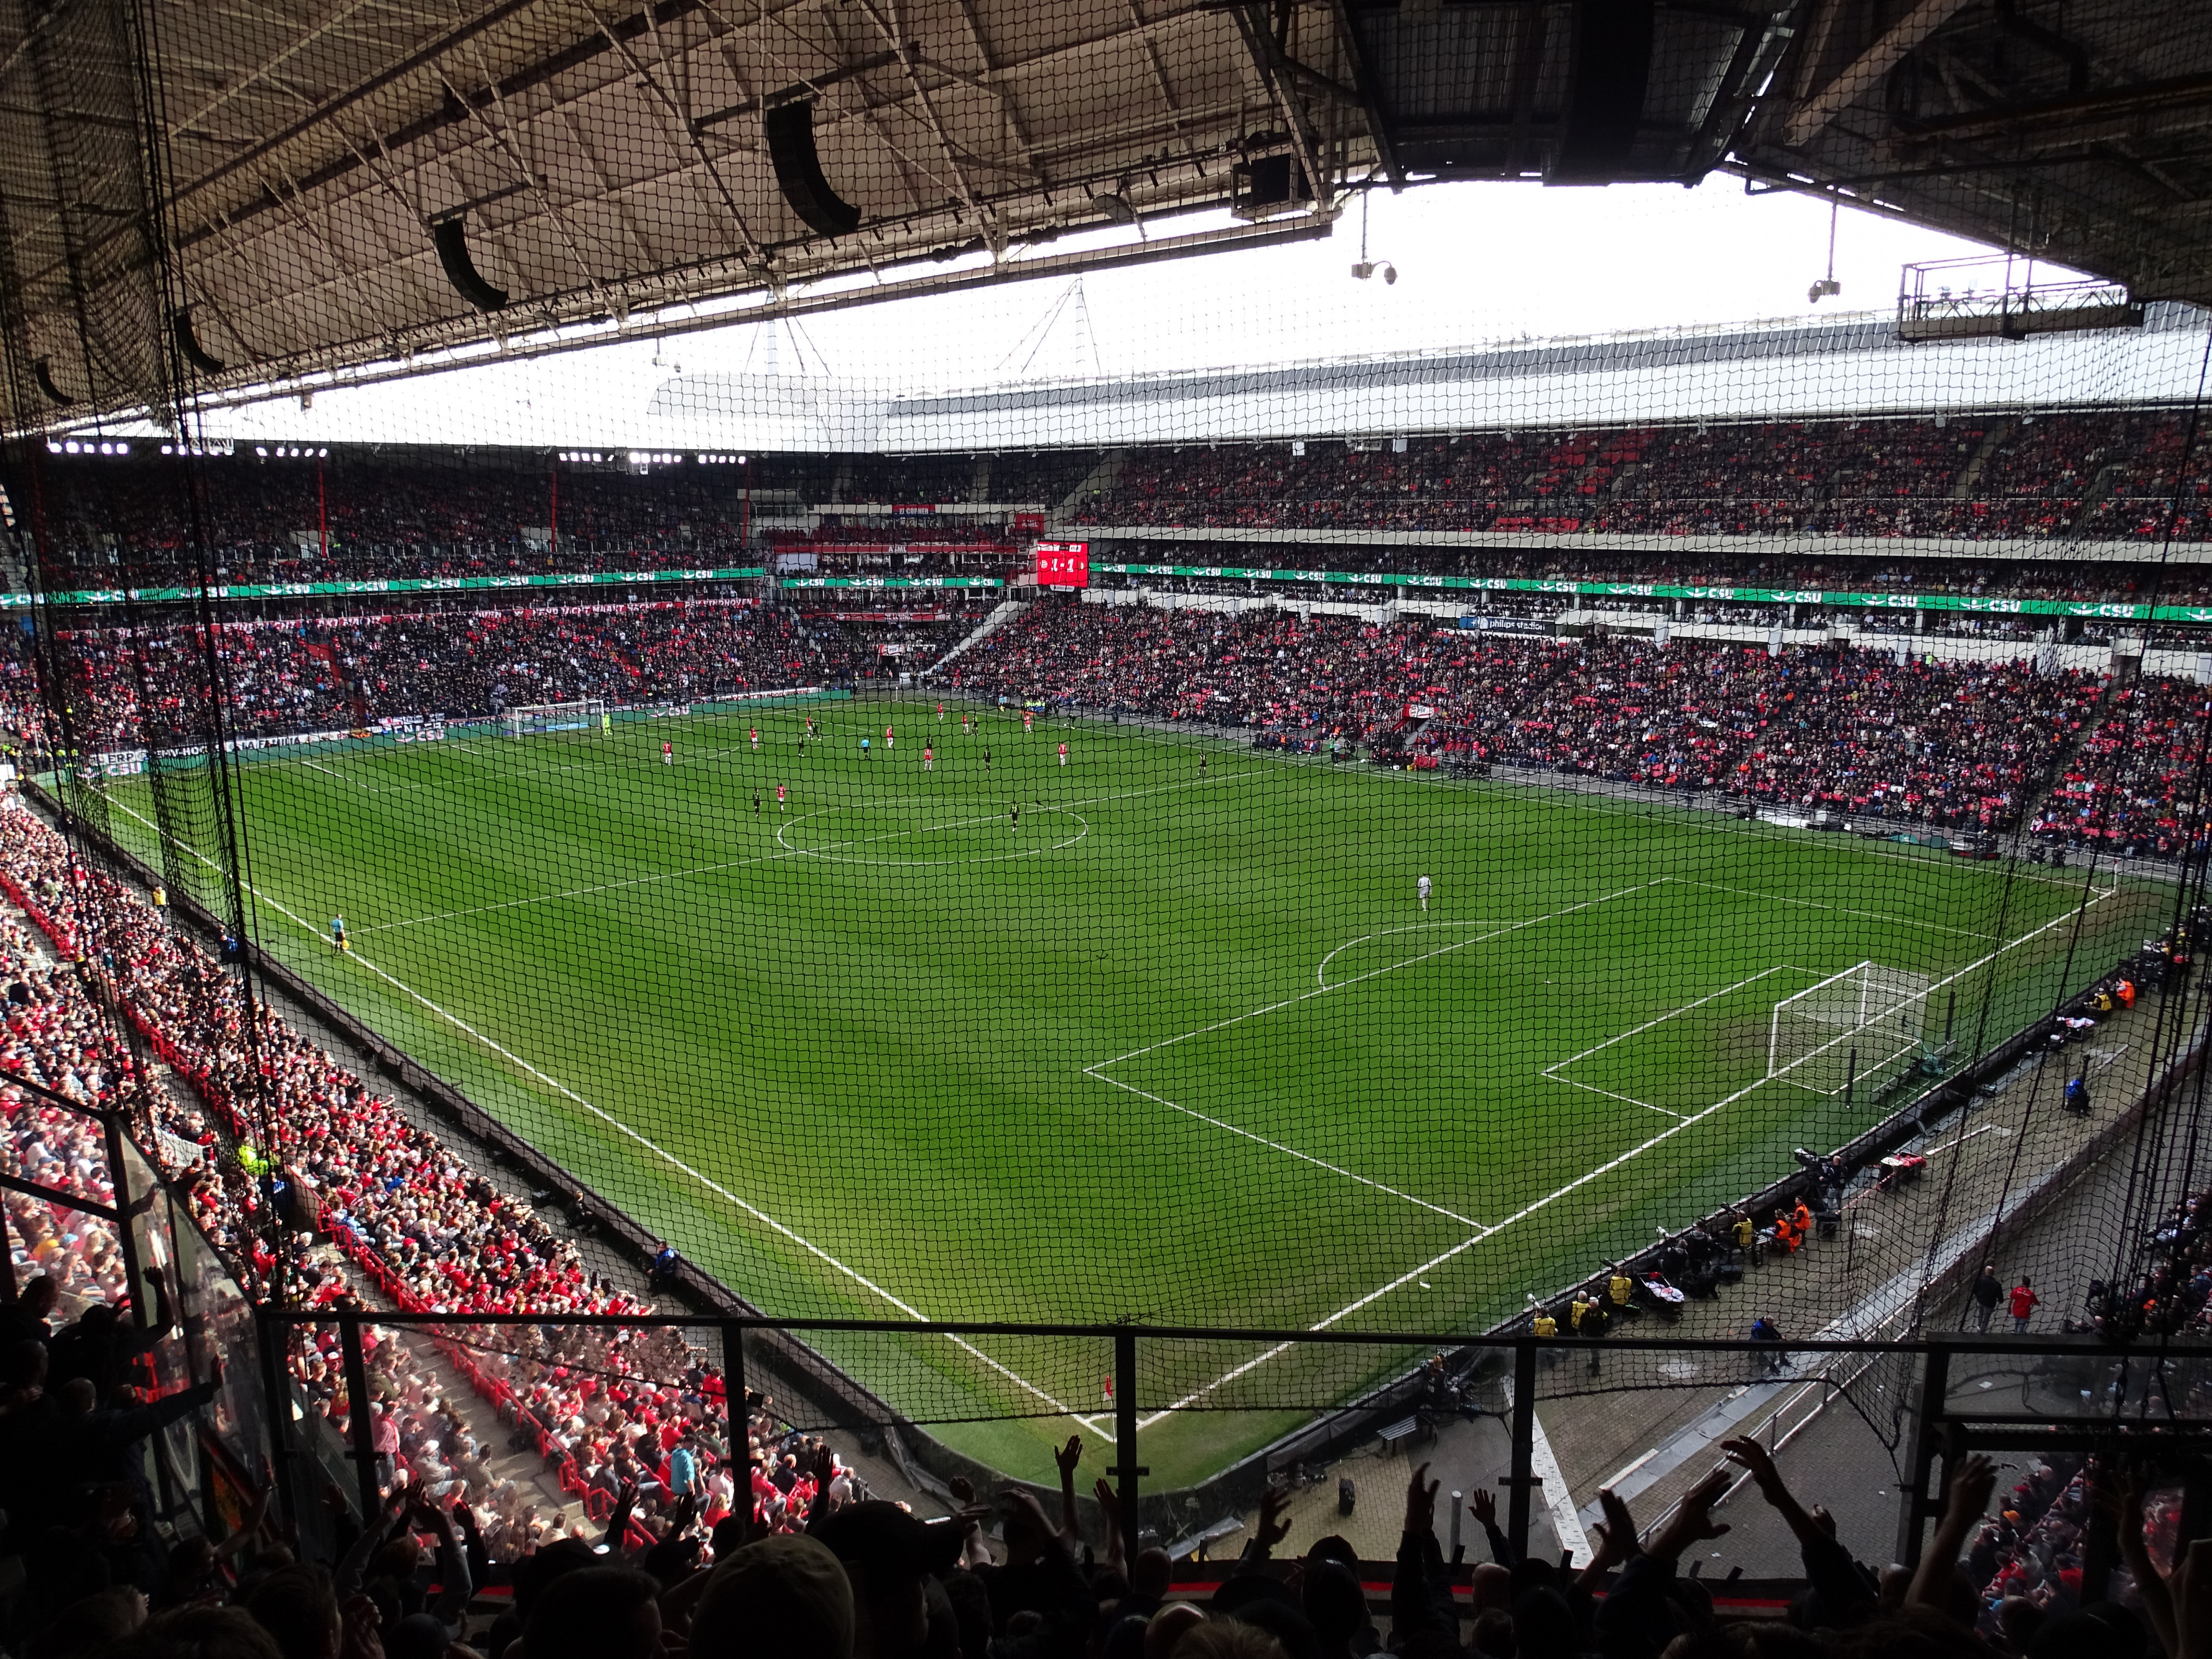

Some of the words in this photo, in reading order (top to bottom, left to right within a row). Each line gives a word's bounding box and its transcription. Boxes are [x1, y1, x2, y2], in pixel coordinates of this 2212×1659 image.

[695, 570, 713, 578] CSU
[1112, 565, 1126, 573] CSU
[1158, 566, 1172, 574] CSU
[1206, 568, 1221, 576] CSU
[1256, 570, 1271, 578] CSU
[509, 577, 529, 586] CSU
[574, 575, 594, 584] CSU
[637, 573, 656, 581] CSU
[1308, 572, 1324, 581] CSU
[1363, 574, 1381, 584] CSU
[1423, 577, 1442, 586] CSU
[364, 581, 388, 591] CSU
[440, 579, 460, 588] CSU
[1487, 579, 1507, 589] CSU
[1556, 582, 1577, 592] CSU
[283, 584, 310, 594] CSU
[1629, 585, 1652, 596] CSU
[1708, 588, 1734, 599] CSU
[1795, 592, 1822, 603] CSU
[1888, 596, 1918, 607] CSU
[1988, 600, 2021, 612] CSU
[2099, 604, 2134, 618] CSU
[1490, 620, 1515, 628] philips
[1517, 622, 1545, 631] stadion
[669, 706, 690, 716] CSU
[416, 729, 444, 741] CSU
[107, 762, 142, 777] CSU
